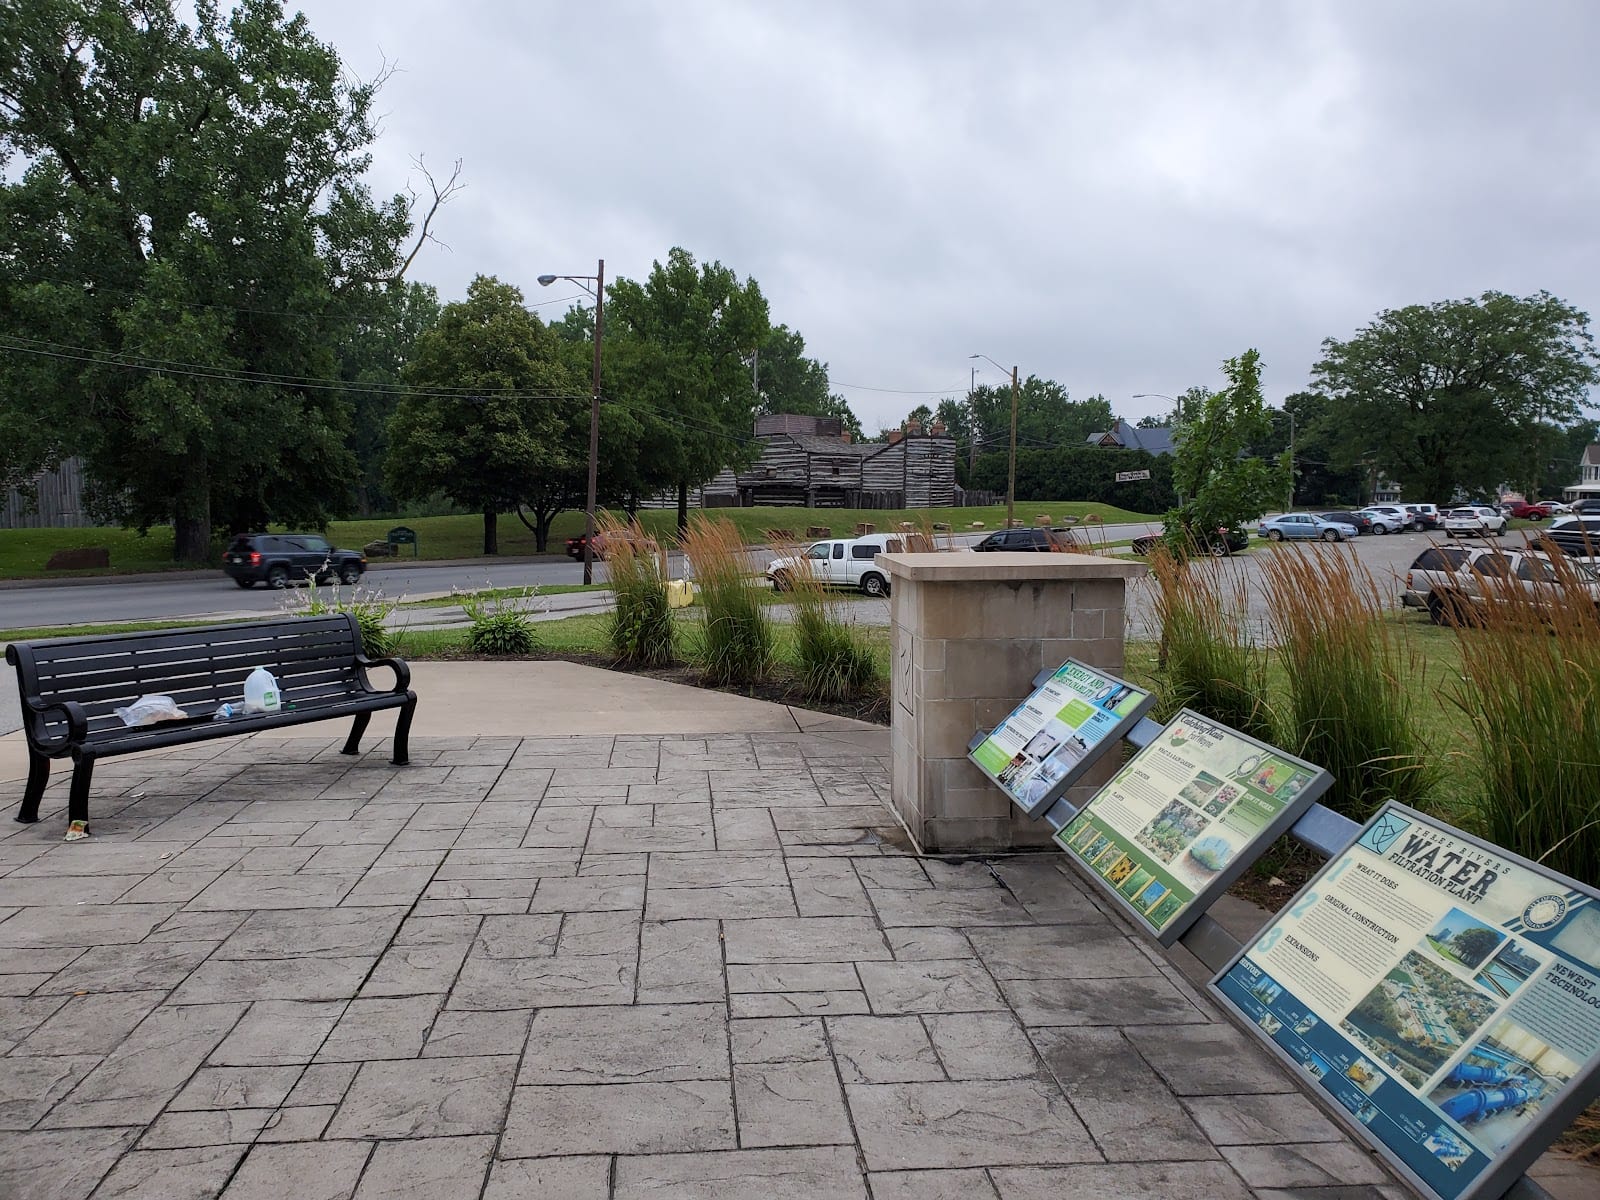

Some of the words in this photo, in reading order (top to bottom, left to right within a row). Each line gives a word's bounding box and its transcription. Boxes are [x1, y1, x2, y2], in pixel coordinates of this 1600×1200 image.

[1415, 826, 1455, 849] THREE
[1458, 847, 1512, 875] RIVERS
[1327, 857, 1353, 882] 1
[1357, 862, 1376, 877] WHAT
[1380, 874, 1399, 890] DOES
[1388, 852, 1447, 887] FILTRATION
[1443, 880, 1483, 905] PLANT
[1400, 834, 1498, 896] WATER
[1289, 892, 1319, 919] 2
[1324, 894, 1352, 916] ORIGINAL
[1351, 911, 1400, 944] CONSTRUCTION
[1257, 927, 1283, 953] 3
[1284, 934, 1320, 962] EXPANSIONS
[1239, 957, 1262, 978] HISTORY
[1552, 963, 1597, 990] NEWEST
